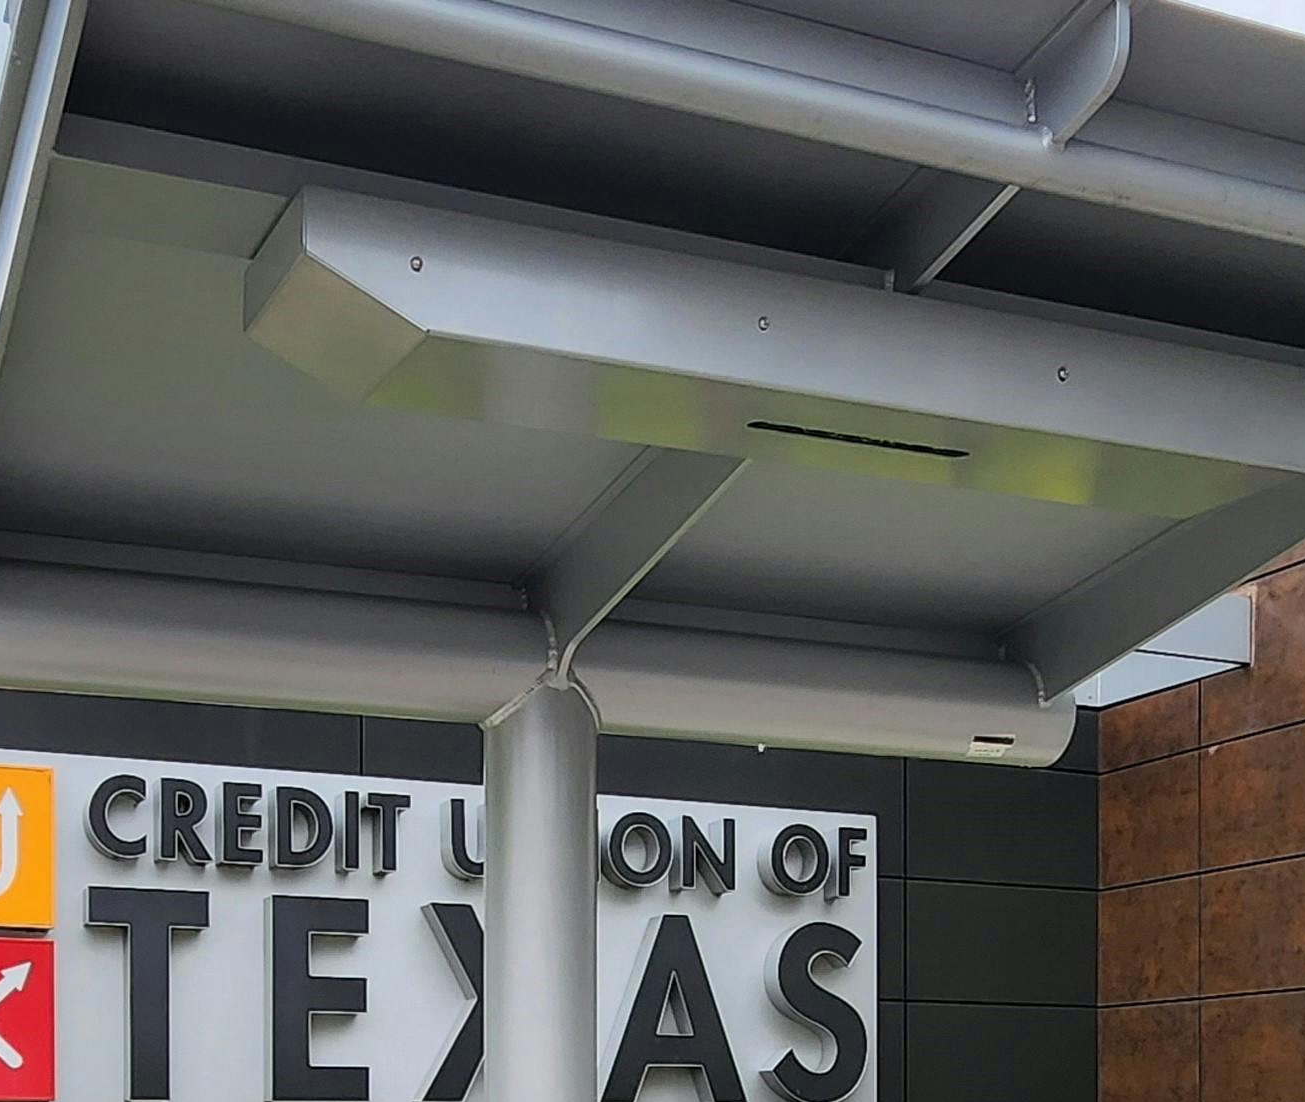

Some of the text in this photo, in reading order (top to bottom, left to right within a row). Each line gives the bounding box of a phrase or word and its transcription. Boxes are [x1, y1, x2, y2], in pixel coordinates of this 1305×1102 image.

[85, 774, 868, 901] CREDIT UON OF
